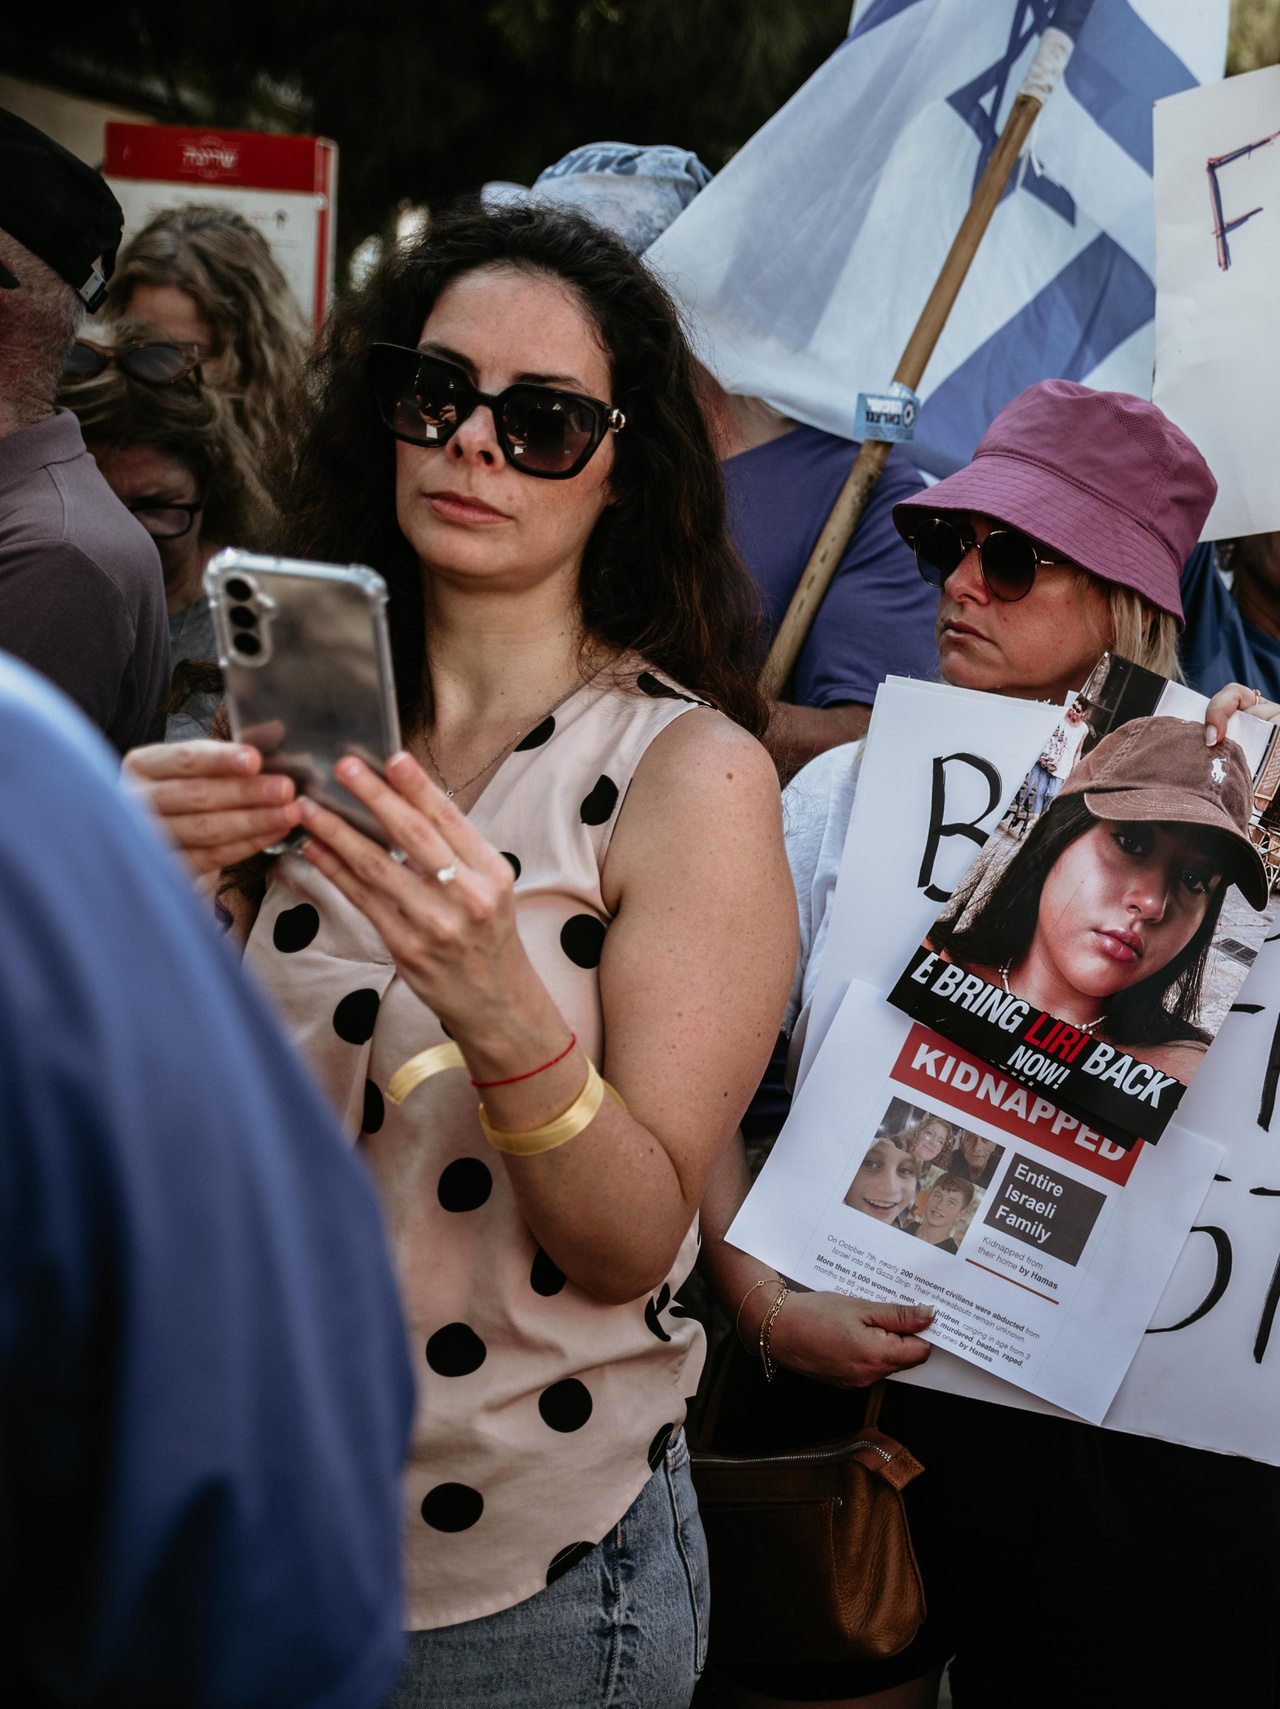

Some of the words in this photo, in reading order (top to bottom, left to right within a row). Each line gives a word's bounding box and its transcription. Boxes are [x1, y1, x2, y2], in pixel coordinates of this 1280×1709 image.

[930, 964, 1030, 1034] BRING
[1023, 1011, 1088, 1064] LIRI
[1081, 1042, 1177, 1109] BACK
[1007, 1045, 1071, 1090] NOW!
[911, 1042, 1127, 1162] KIDNAPPED
[1004, 1183, 1057, 1219] Israeli
[1013, 1162, 1064, 1197] Entire
[994, 1207, 1052, 1244] Family
[978, 1247, 995, 1258] their
[996, 1255, 1017, 1270] home
[1019, 1266, 1030, 1276] by
[1031, 1272, 1058, 1289] Hamas
[983, 1236, 1025, 1260] Kidnapped
[1026, 1256, 1043, 1270] from
[814, 1265, 838, 1279] months
[846, 1279, 856, 1287] 85
[856, 1285, 874, 1296] years
[828, 1235, 837, 1243] On
[839, 1240, 864, 1256] October
[879, 1260, 899, 1273] nearly
[900, 1269, 913, 1278] 200
[914, 1275, 945, 1293] innocent
[946, 1290, 974, 1307] civilians
[975, 1304, 991, 1315] were
[992, 1313, 1025, 1331] abducted
[1025, 1328, 1040, 1339] from
[832, 1247, 851, 1259] Israel
[851, 1258, 863, 1266] into
[862, 1263, 875, 1271] the
[876, 1268, 893, 1280] Gaza
[914, 1284, 930, 1296] Their
[932, 1294, 972, 1316] whereabouts
[973, 1314, 995, 1327] remain
[816, 1255, 834, 1267] More
[835, 1264, 850, 1274] than
[852, 1272, 870, 1284] 3,000
[872, 1281, 897, 1297] women,
[900, 1294, 915, 1308] men,
[962, 1324, 987, 1340] ranging
[996, 1340, 1008, 1349] age
[1009, 1345, 1024, 1357] from
[835, 1286, 848, 1296] and
[942, 1335, 958, 1344] ones
[959, 1341, 968, 1350] by
